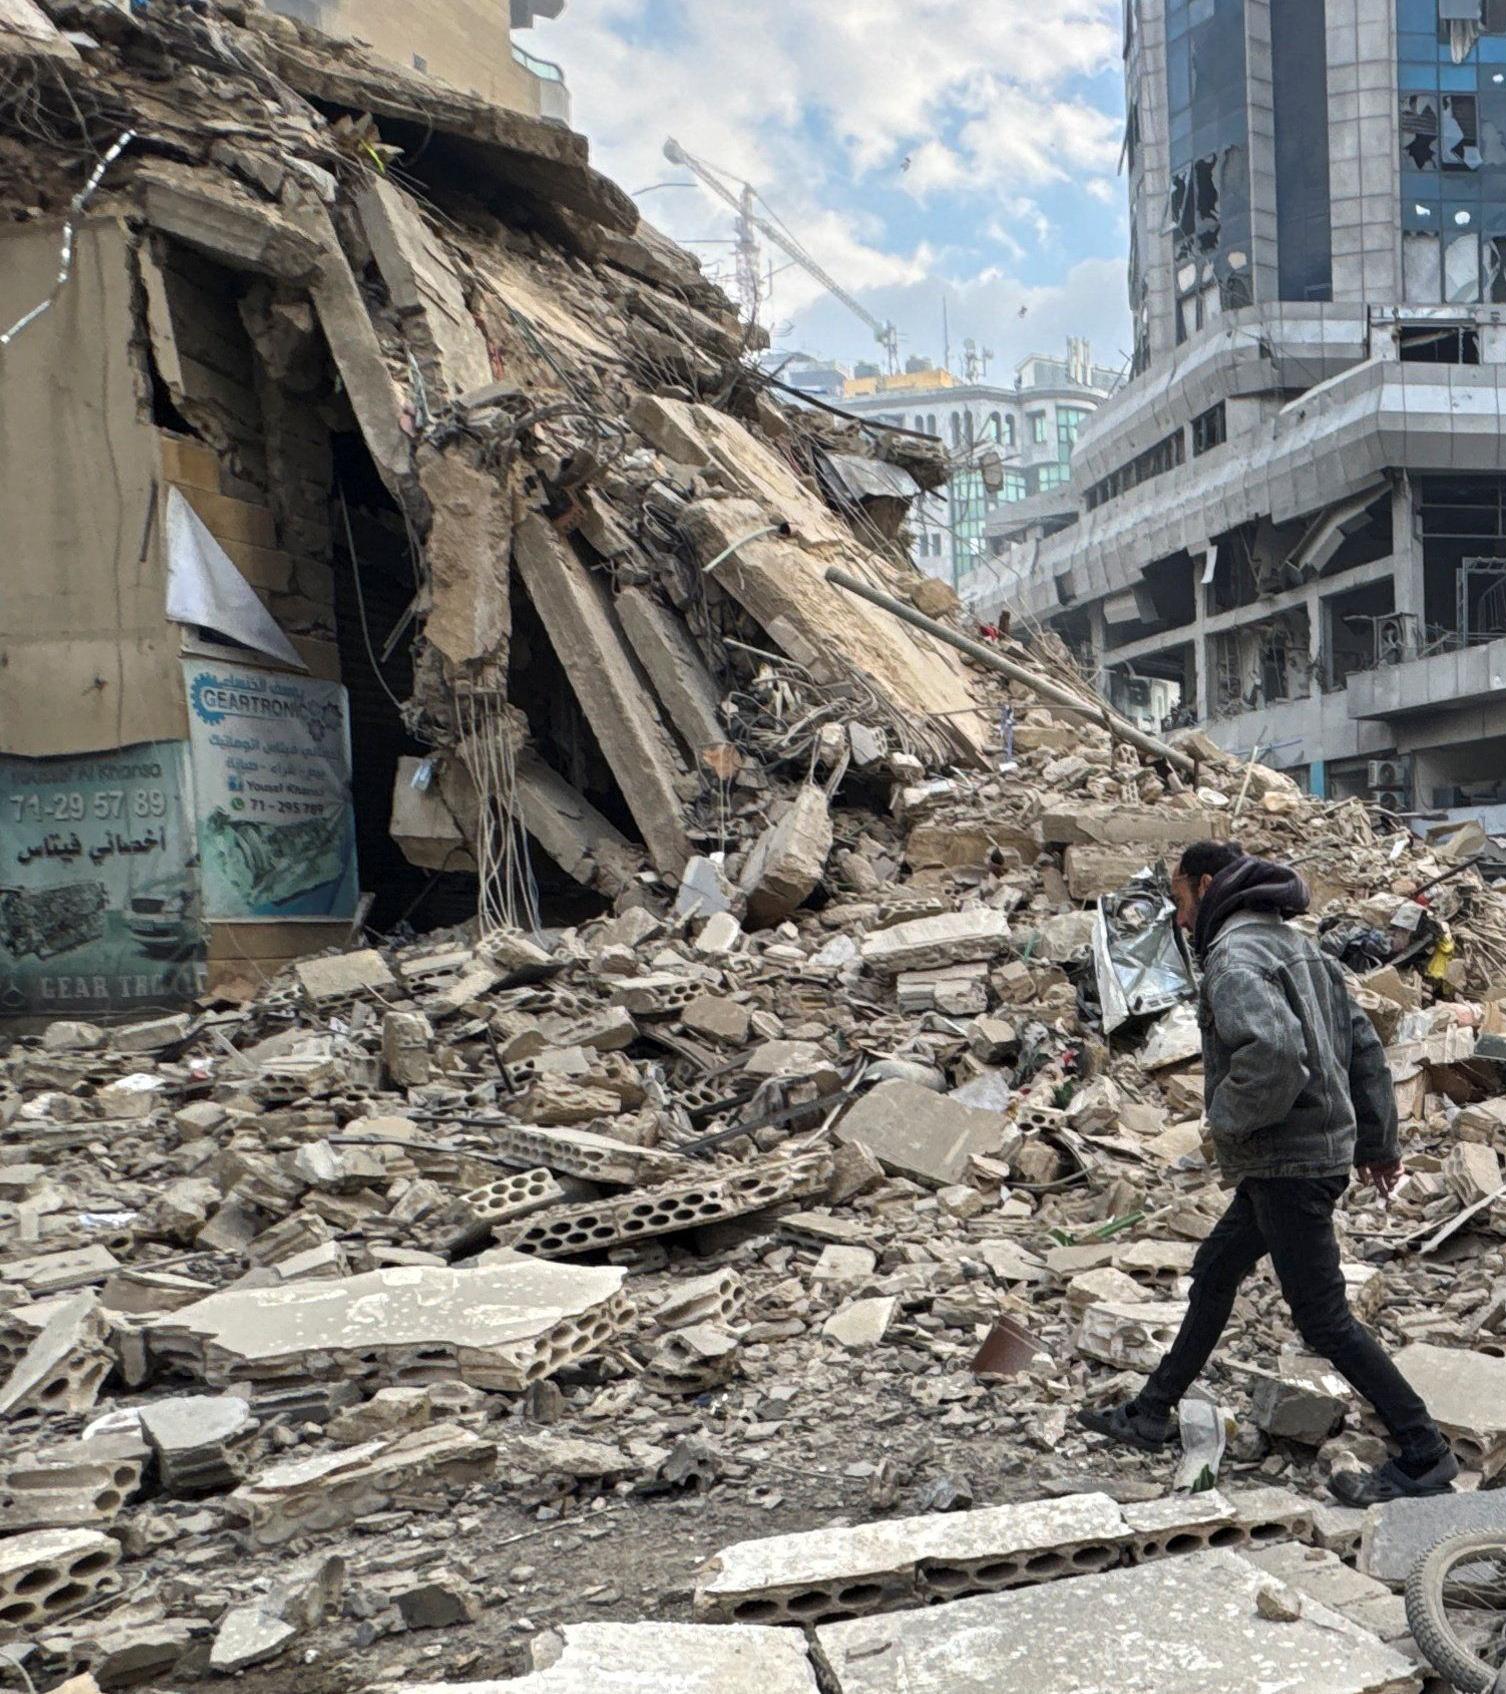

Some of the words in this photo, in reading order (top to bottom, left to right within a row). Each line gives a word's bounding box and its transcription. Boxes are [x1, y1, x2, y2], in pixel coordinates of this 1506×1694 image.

[94, 789, 124, 820] 57
[135, 787, 167, 818] 89
[41, 974, 109, 999] GEAR
